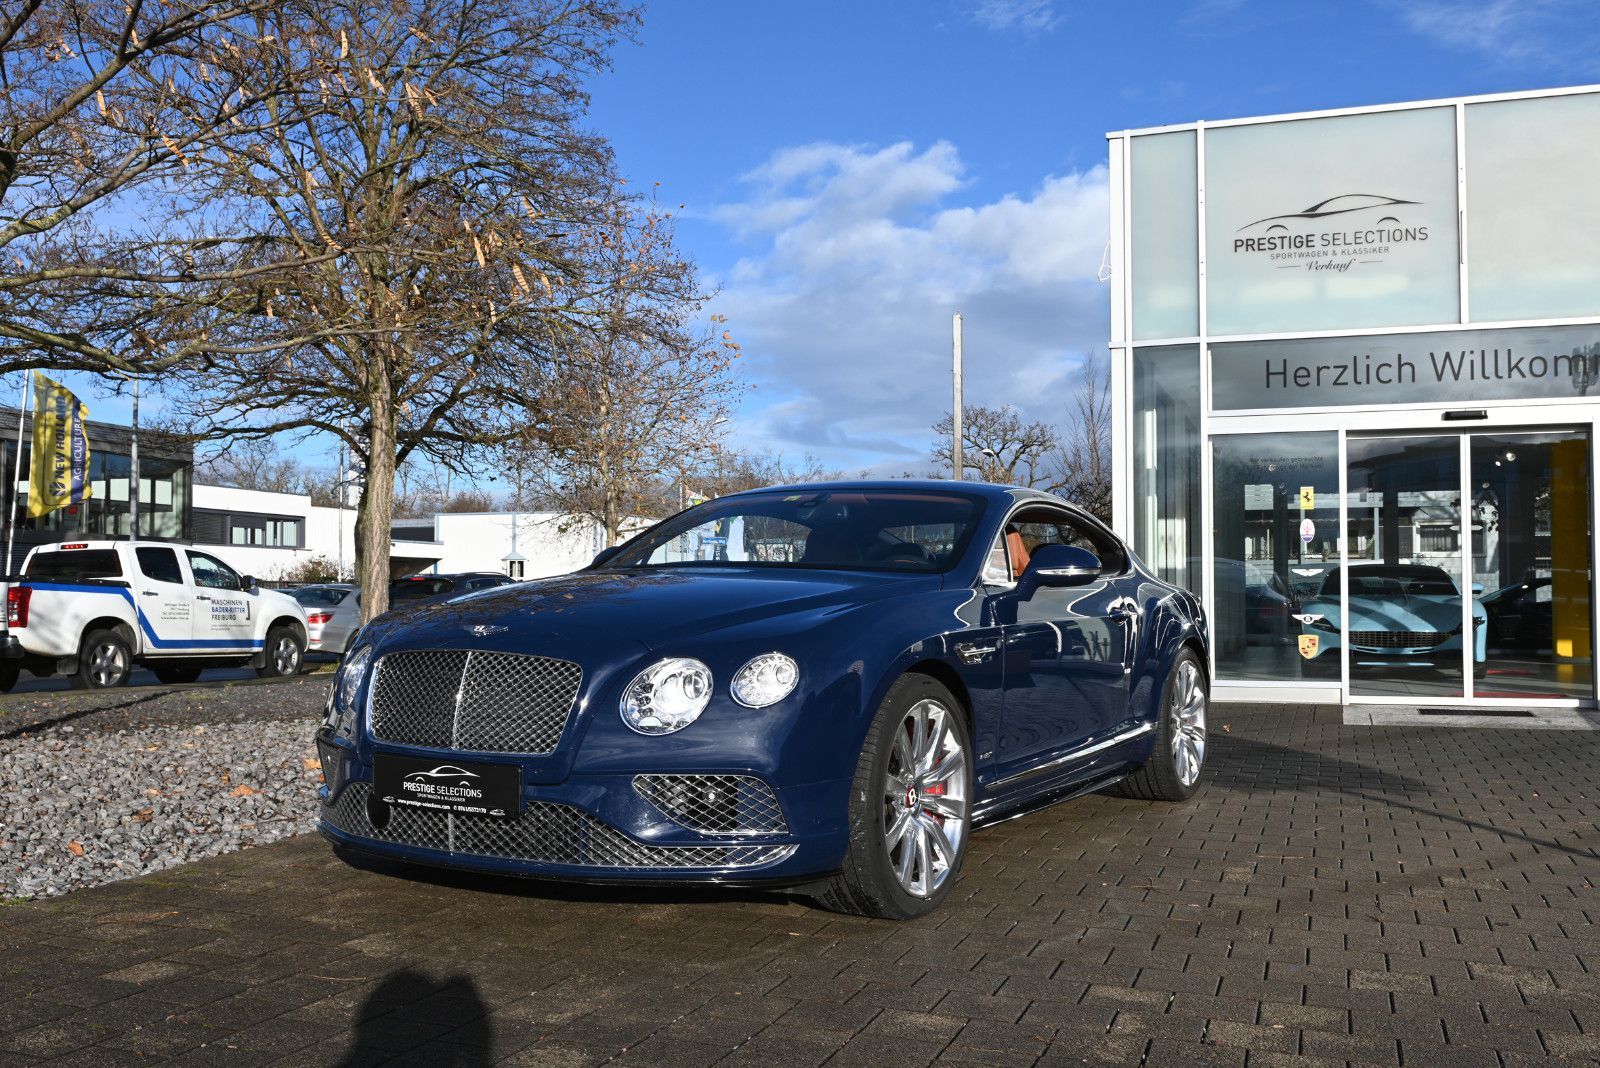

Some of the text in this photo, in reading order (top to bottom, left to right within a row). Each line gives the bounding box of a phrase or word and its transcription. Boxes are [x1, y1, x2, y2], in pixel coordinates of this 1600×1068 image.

[1234, 227, 1429, 253] PRESTIGE SELECTIONS
[1270, 250, 1329, 261] SPORTWAGEN
[1341, 246, 1390, 255] KLASSIKER
[1306, 258, 1356, 272] Verkauf
[1265, 353, 1416, 389] Herzlich
[55, 395, 66, 479] NEW HOLLAND
[73, 418, 82, 480] AGRICULTURE
[403, 781, 482, 798] PRESTIGE SELECTIONS
